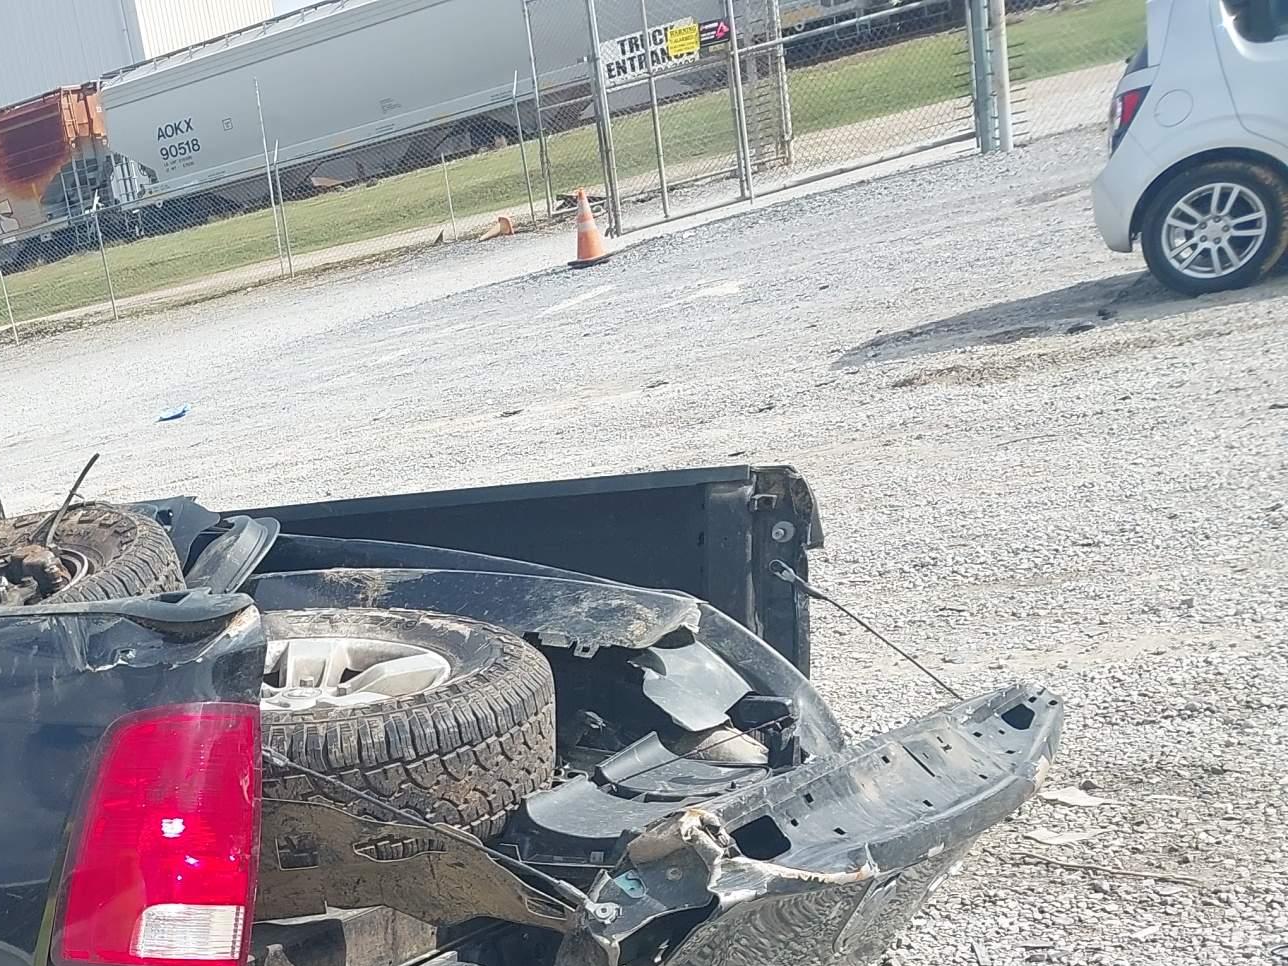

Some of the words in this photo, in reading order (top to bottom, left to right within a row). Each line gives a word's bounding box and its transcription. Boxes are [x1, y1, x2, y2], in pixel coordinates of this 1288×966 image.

[606, 46, 695, 80] ENTRAN
[157, 118, 194, 141] AOKX
[160, 138, 201, 160] 90518
